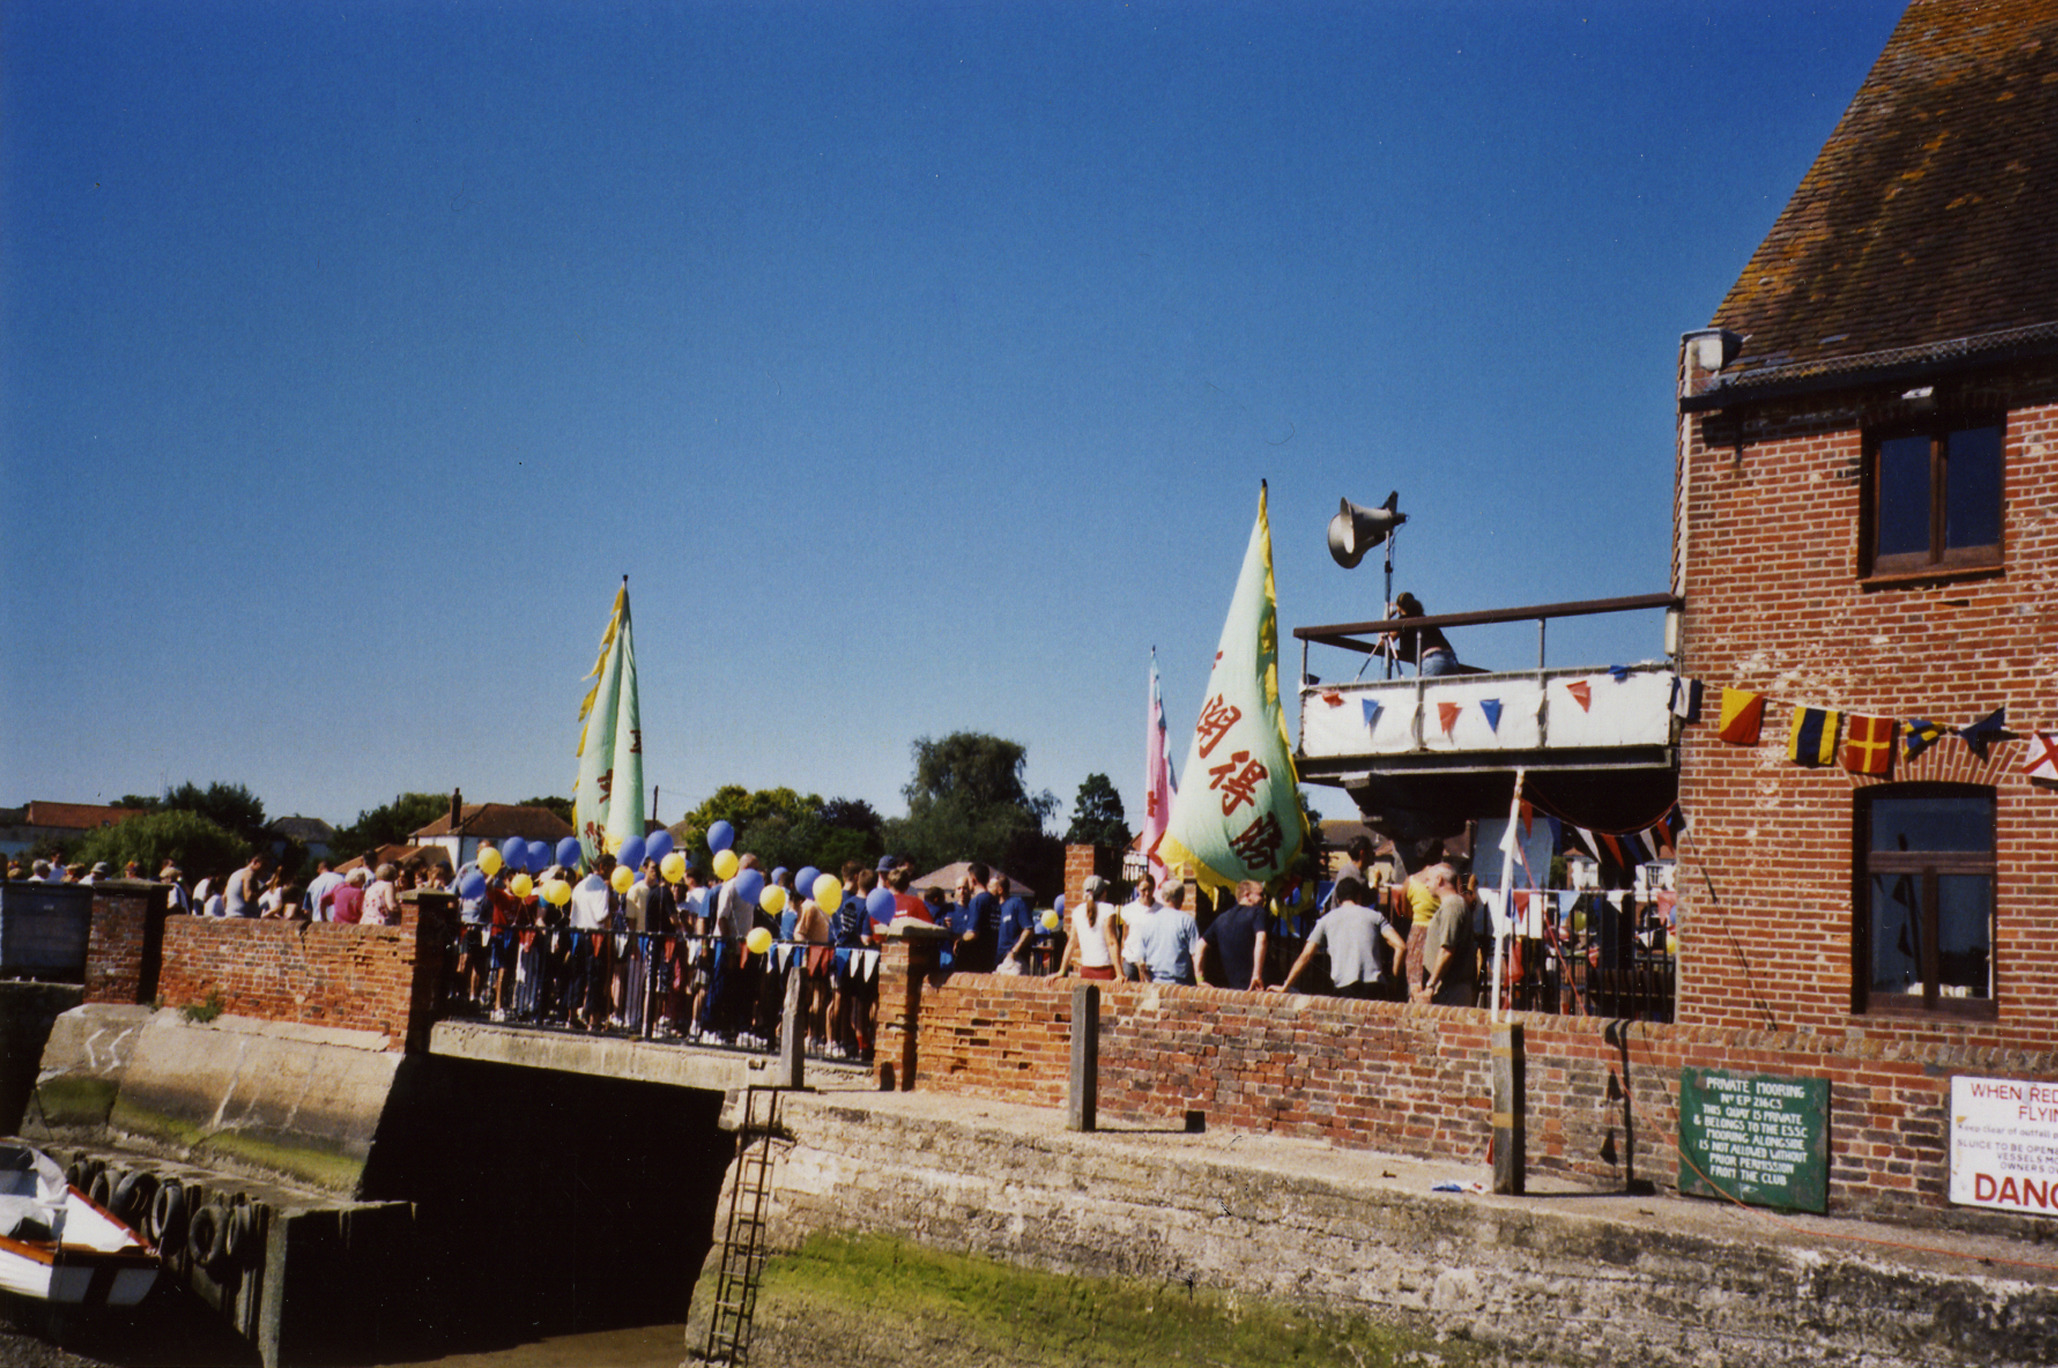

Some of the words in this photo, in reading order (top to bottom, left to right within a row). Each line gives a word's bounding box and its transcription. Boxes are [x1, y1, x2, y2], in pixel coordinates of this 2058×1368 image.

[1196, 651, 1283, 871] 開得勝
[1706, 1077, 1750, 1093] PRIVATE
[1756, 1081, 1805, 1098] MOORING
[1970, 1083, 2022, 1100] WHEN
[1736, 1094, 1751, 1106] EP
[1703, 1103, 1721, 1115] THIS
[1725, 1106, 1750, 1119] QUAY
[1753, 1109, 1762, 1121] IS
[1764, 1111, 1803, 1125] PRIVATE
[1693, 1114, 1701, 1126] &
[1704, 1115, 1745, 1131] BELONGS
[1748, 1121, 1759, 1133] TO
[1761, 1122, 1779, 1135] THE
[1781, 1125, 1808, 1138] ESSC
[2008, 1127, 2017, 1136] of
[2020, 1129, 2051, 1139] outfall
[1706, 1128, 1749, 1144] MOORING
[1752, 1135, 1805, 1150] ALONGSIDE
[1957, 1139, 1991, 1150] SLUICE
[1995, 1142, 2008, 1151] TO
[2010, 1143, 2023, 1153] BE
[1699, 1139, 1709, 1151] IS
[1711, 1140, 1730, 1153] NOT
[1730, 1144, 1767, 1159] ALLOWED
[1769, 1148, 1808, 1163] WITHOUT
[1997, 1152, 2042, 1163] VESSELS
[1709, 1152, 1737, 1167] PRIOR
[1739, 1156, 1794, 1174] PERMISSION
[2000, 1161, 2045, 1173] OWNERS
[1710, 1164, 1736, 1179] FROM
[1740, 1168, 1758, 1183] THE
[1761, 1172, 1787, 1186] CLUB
[1974, 1172, 2058, 1210] DAN
